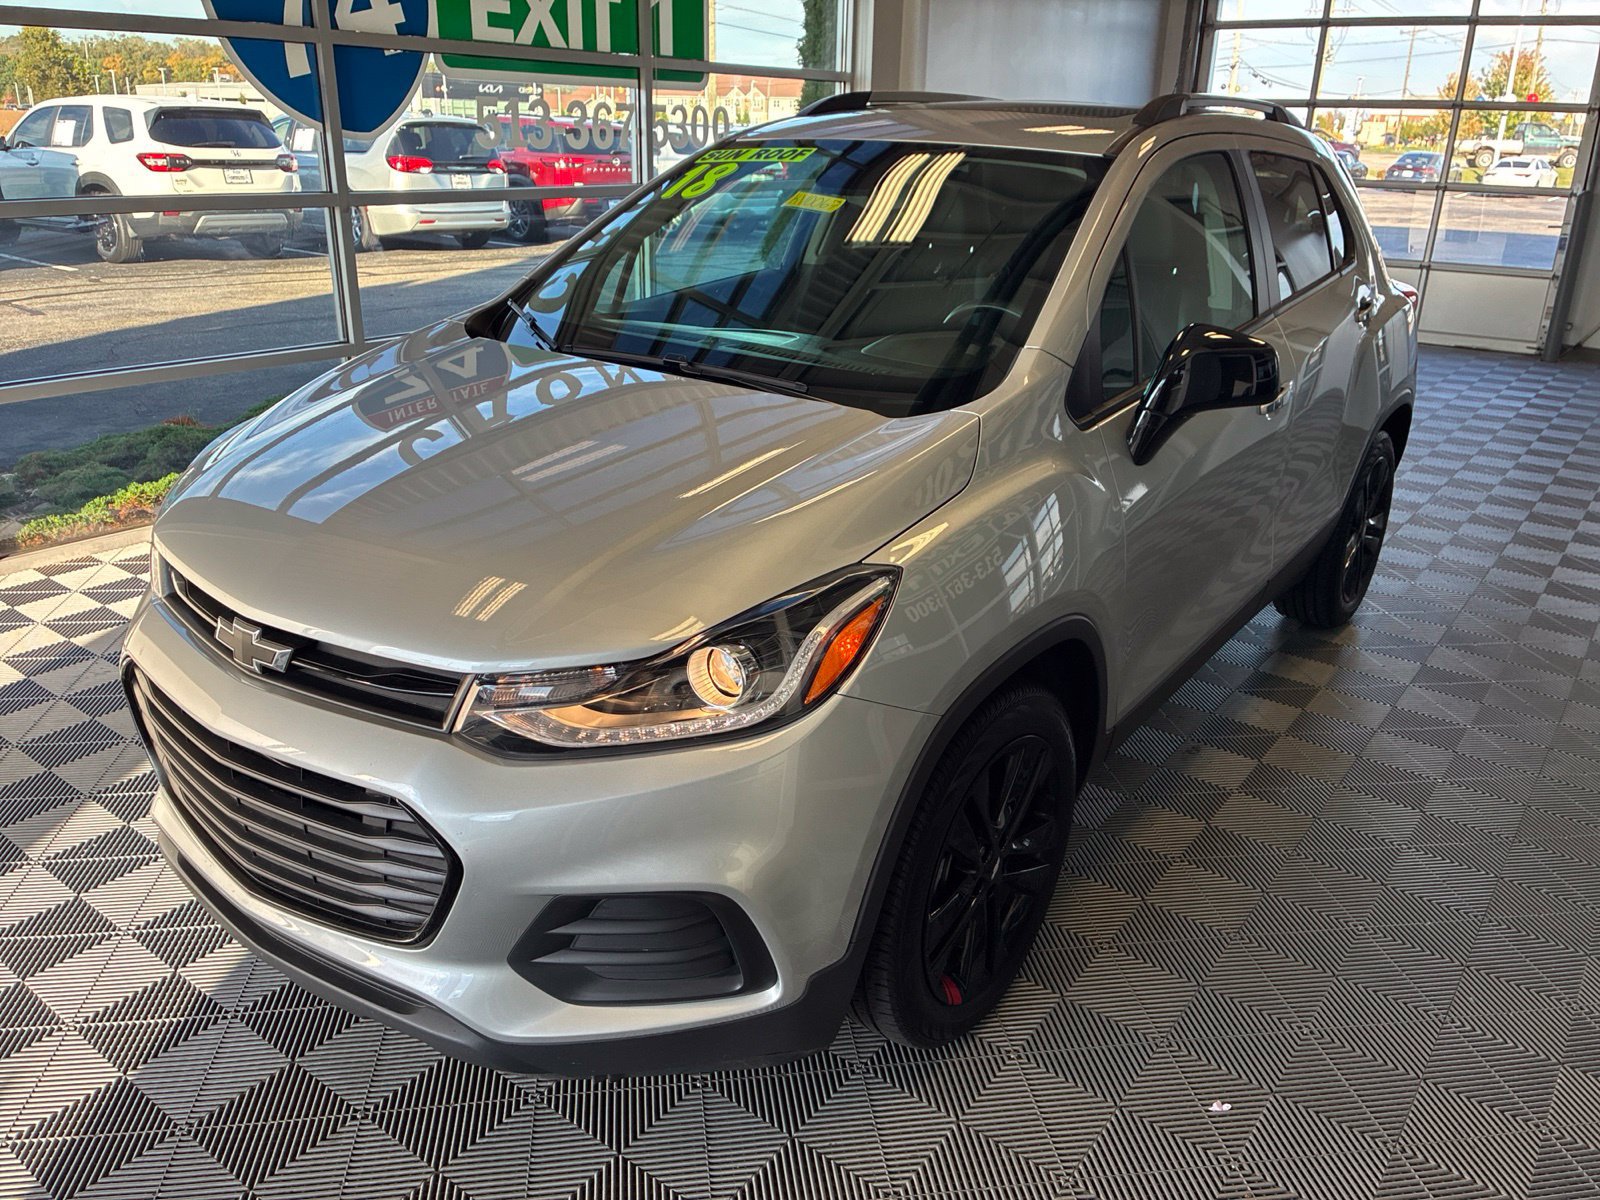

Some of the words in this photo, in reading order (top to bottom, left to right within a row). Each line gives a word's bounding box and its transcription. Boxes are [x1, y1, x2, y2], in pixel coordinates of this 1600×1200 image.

[470, 0, 621, 52] EXIT
[701, 149, 744, 161] SUN
[750, 148, 809, 160] ROOF
[661, 163, 740, 199] 18
